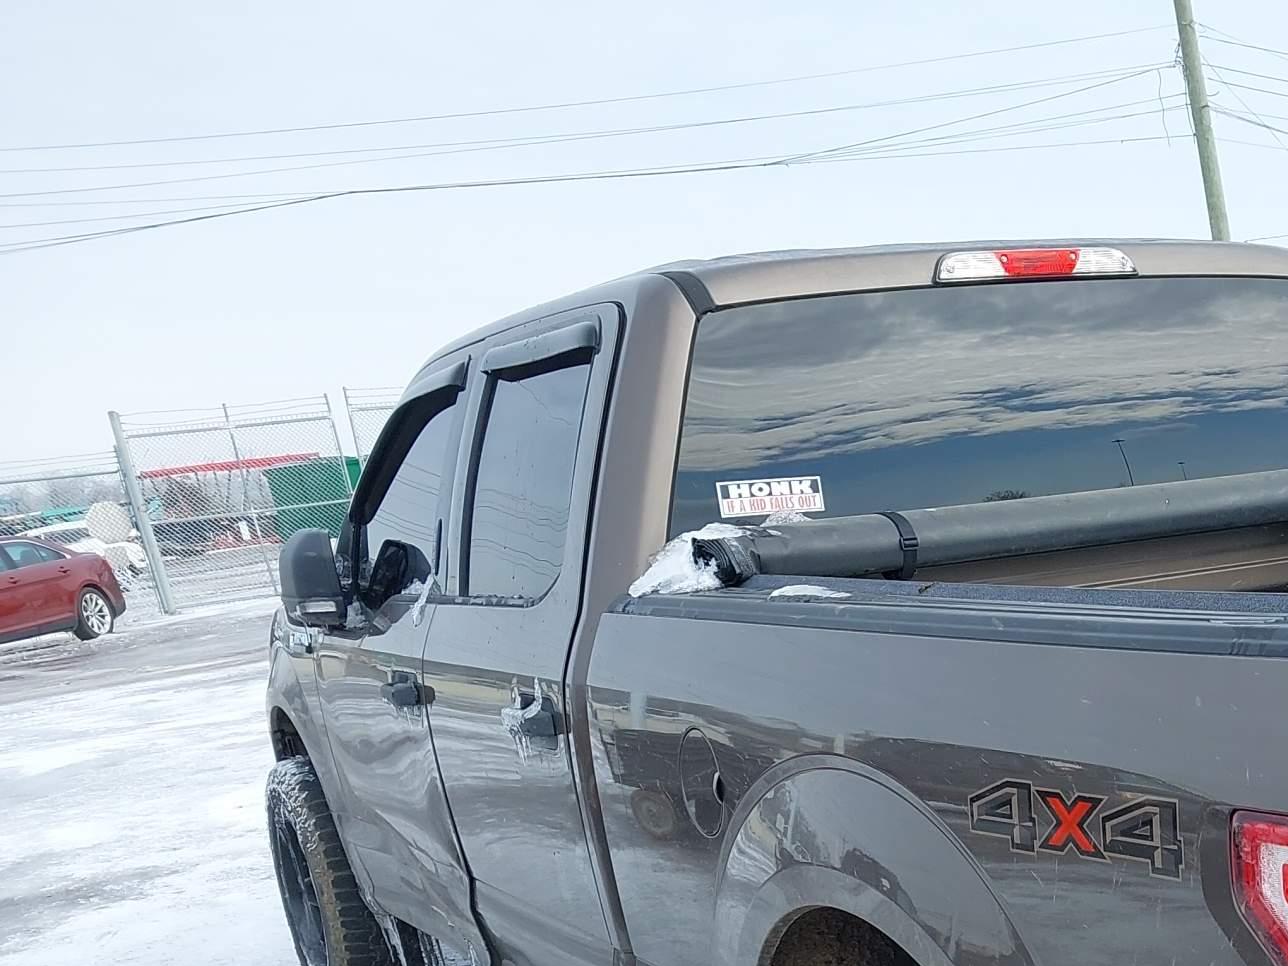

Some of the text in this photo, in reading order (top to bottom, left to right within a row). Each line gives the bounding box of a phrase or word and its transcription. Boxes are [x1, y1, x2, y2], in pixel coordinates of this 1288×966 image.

[728, 480, 814, 499] HONK
[726, 495, 817, 513] IF A KID FALLS OUT
